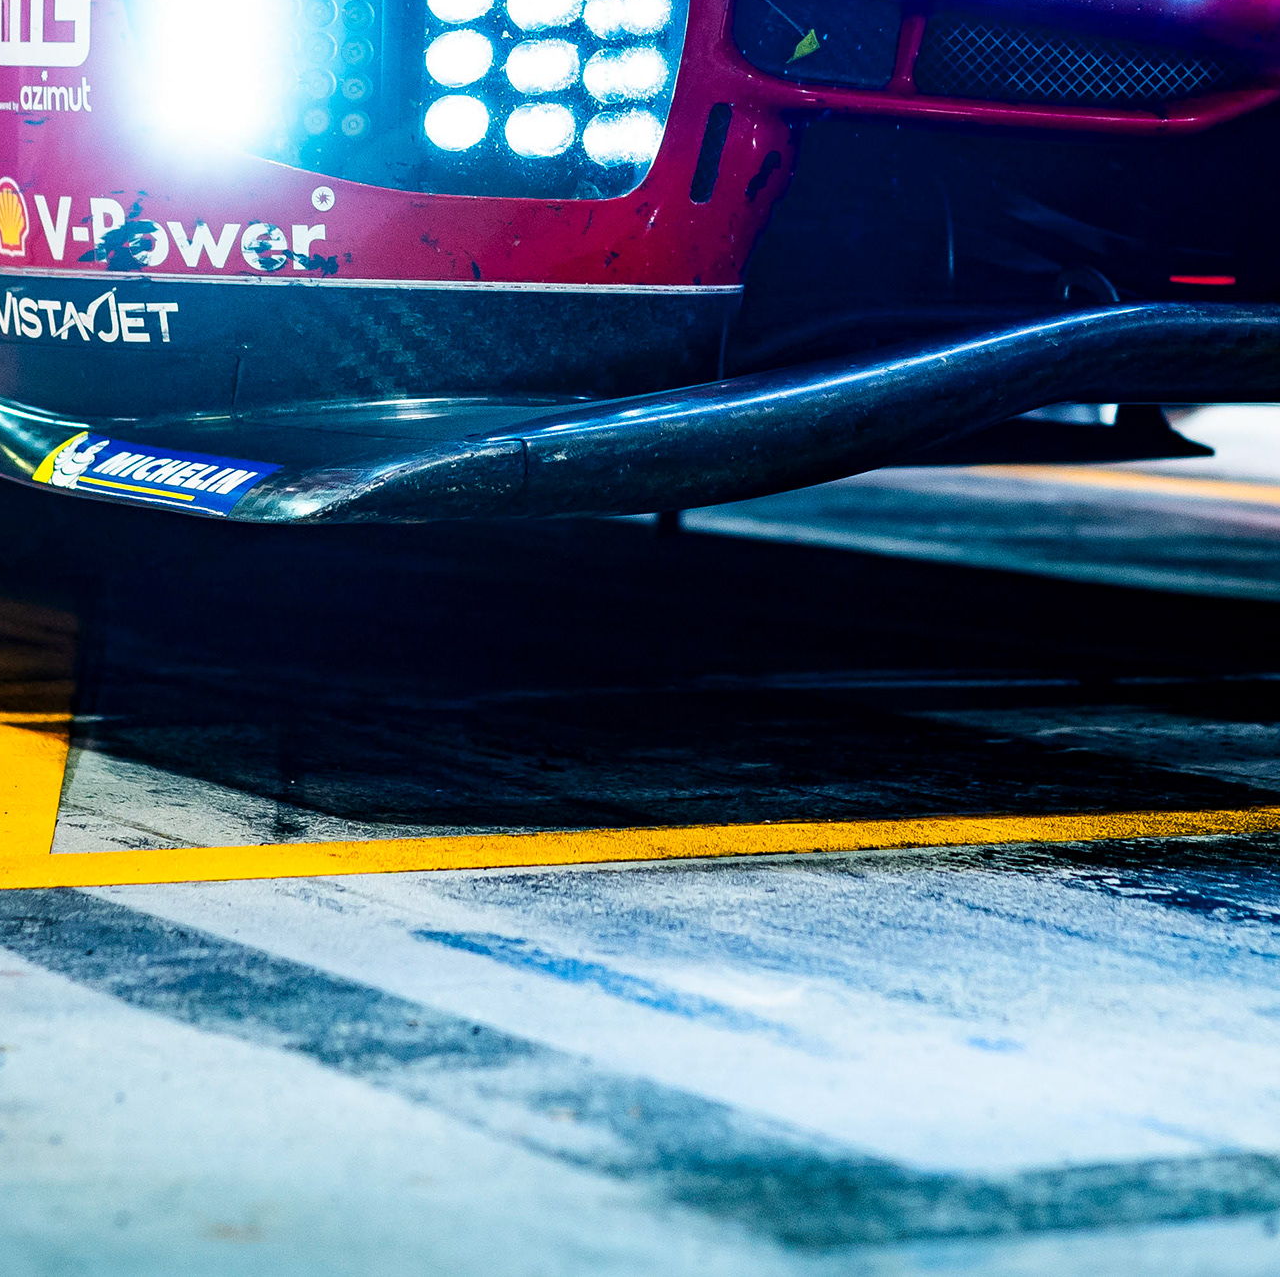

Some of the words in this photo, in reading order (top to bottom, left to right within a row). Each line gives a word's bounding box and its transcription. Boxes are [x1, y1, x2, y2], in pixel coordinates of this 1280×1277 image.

[20, 70, 92, 113] azimut
[34, 194, 327, 271] V-Power
[93, 451, 258, 494] MICHELIN
